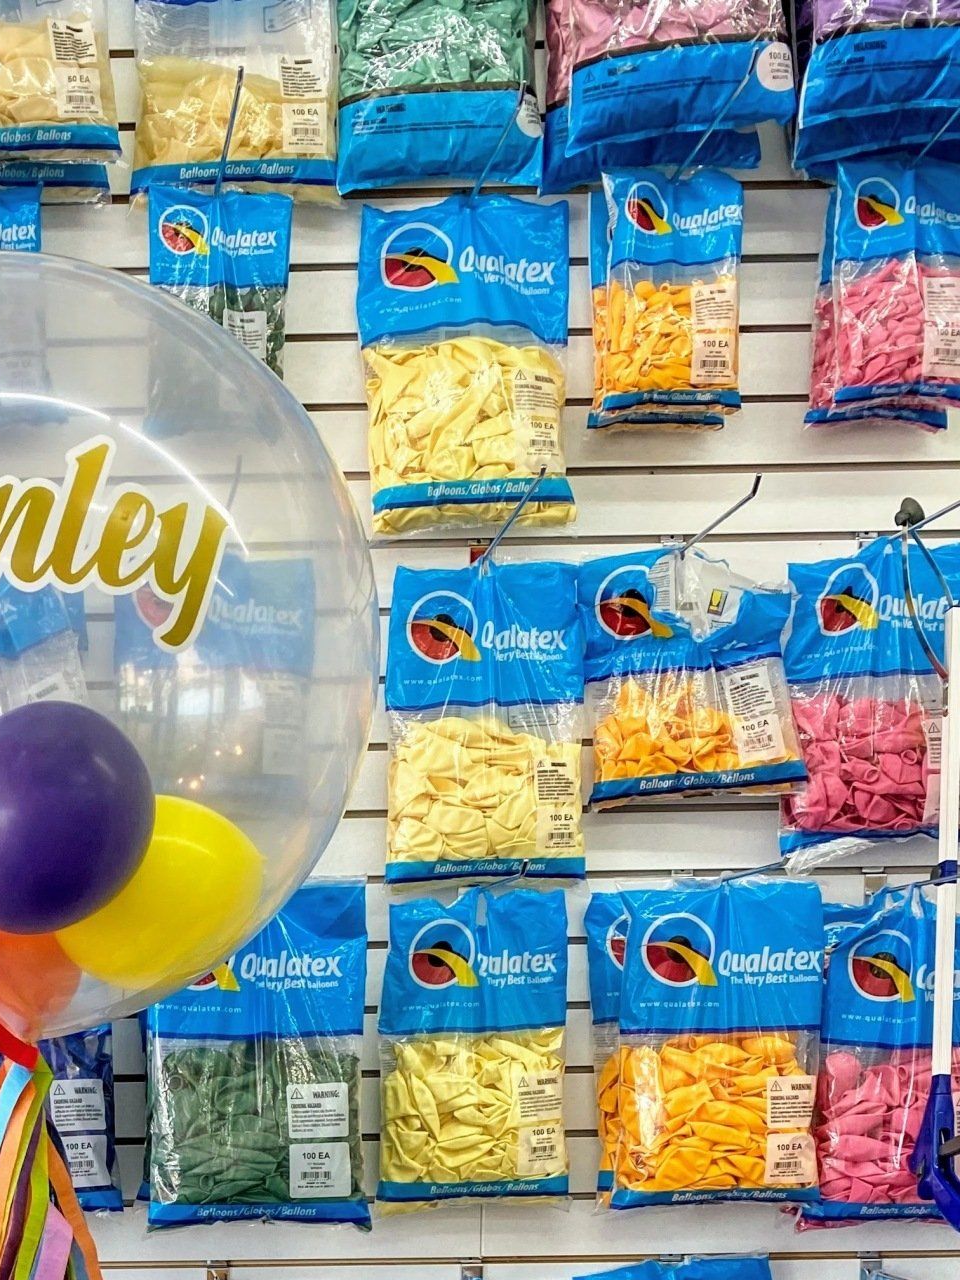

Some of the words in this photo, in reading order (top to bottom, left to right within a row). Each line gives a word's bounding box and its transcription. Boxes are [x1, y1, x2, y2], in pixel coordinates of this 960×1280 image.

[291, 108, 306, 116] 100
[307, 108, 319, 116] EA
[211, 225, 278, 249] Qualatex
[458, 245, 555, 285] Qualatex
[702, 339, 717, 349] 100
[718, 339, 730, 349] EA
[549, 813, 563, 823] 100
[563, 813, 575, 822] EA
[240, 952, 344, 981] Qualatex
[718, 946, 822, 977] Qualatex
[744, 973, 765, 986] Very
[766, 972, 788, 984] Best
[789, 973, 819, 984] Balloons
[65, 1142, 79, 1150] 100
[80, 1142, 93, 1150] EA
[776, 1143, 790, 1151] 100
[791, 1142, 803, 1151] EA
[301, 1151, 317, 1161] 100
[318, 1151, 331, 1160] EA
